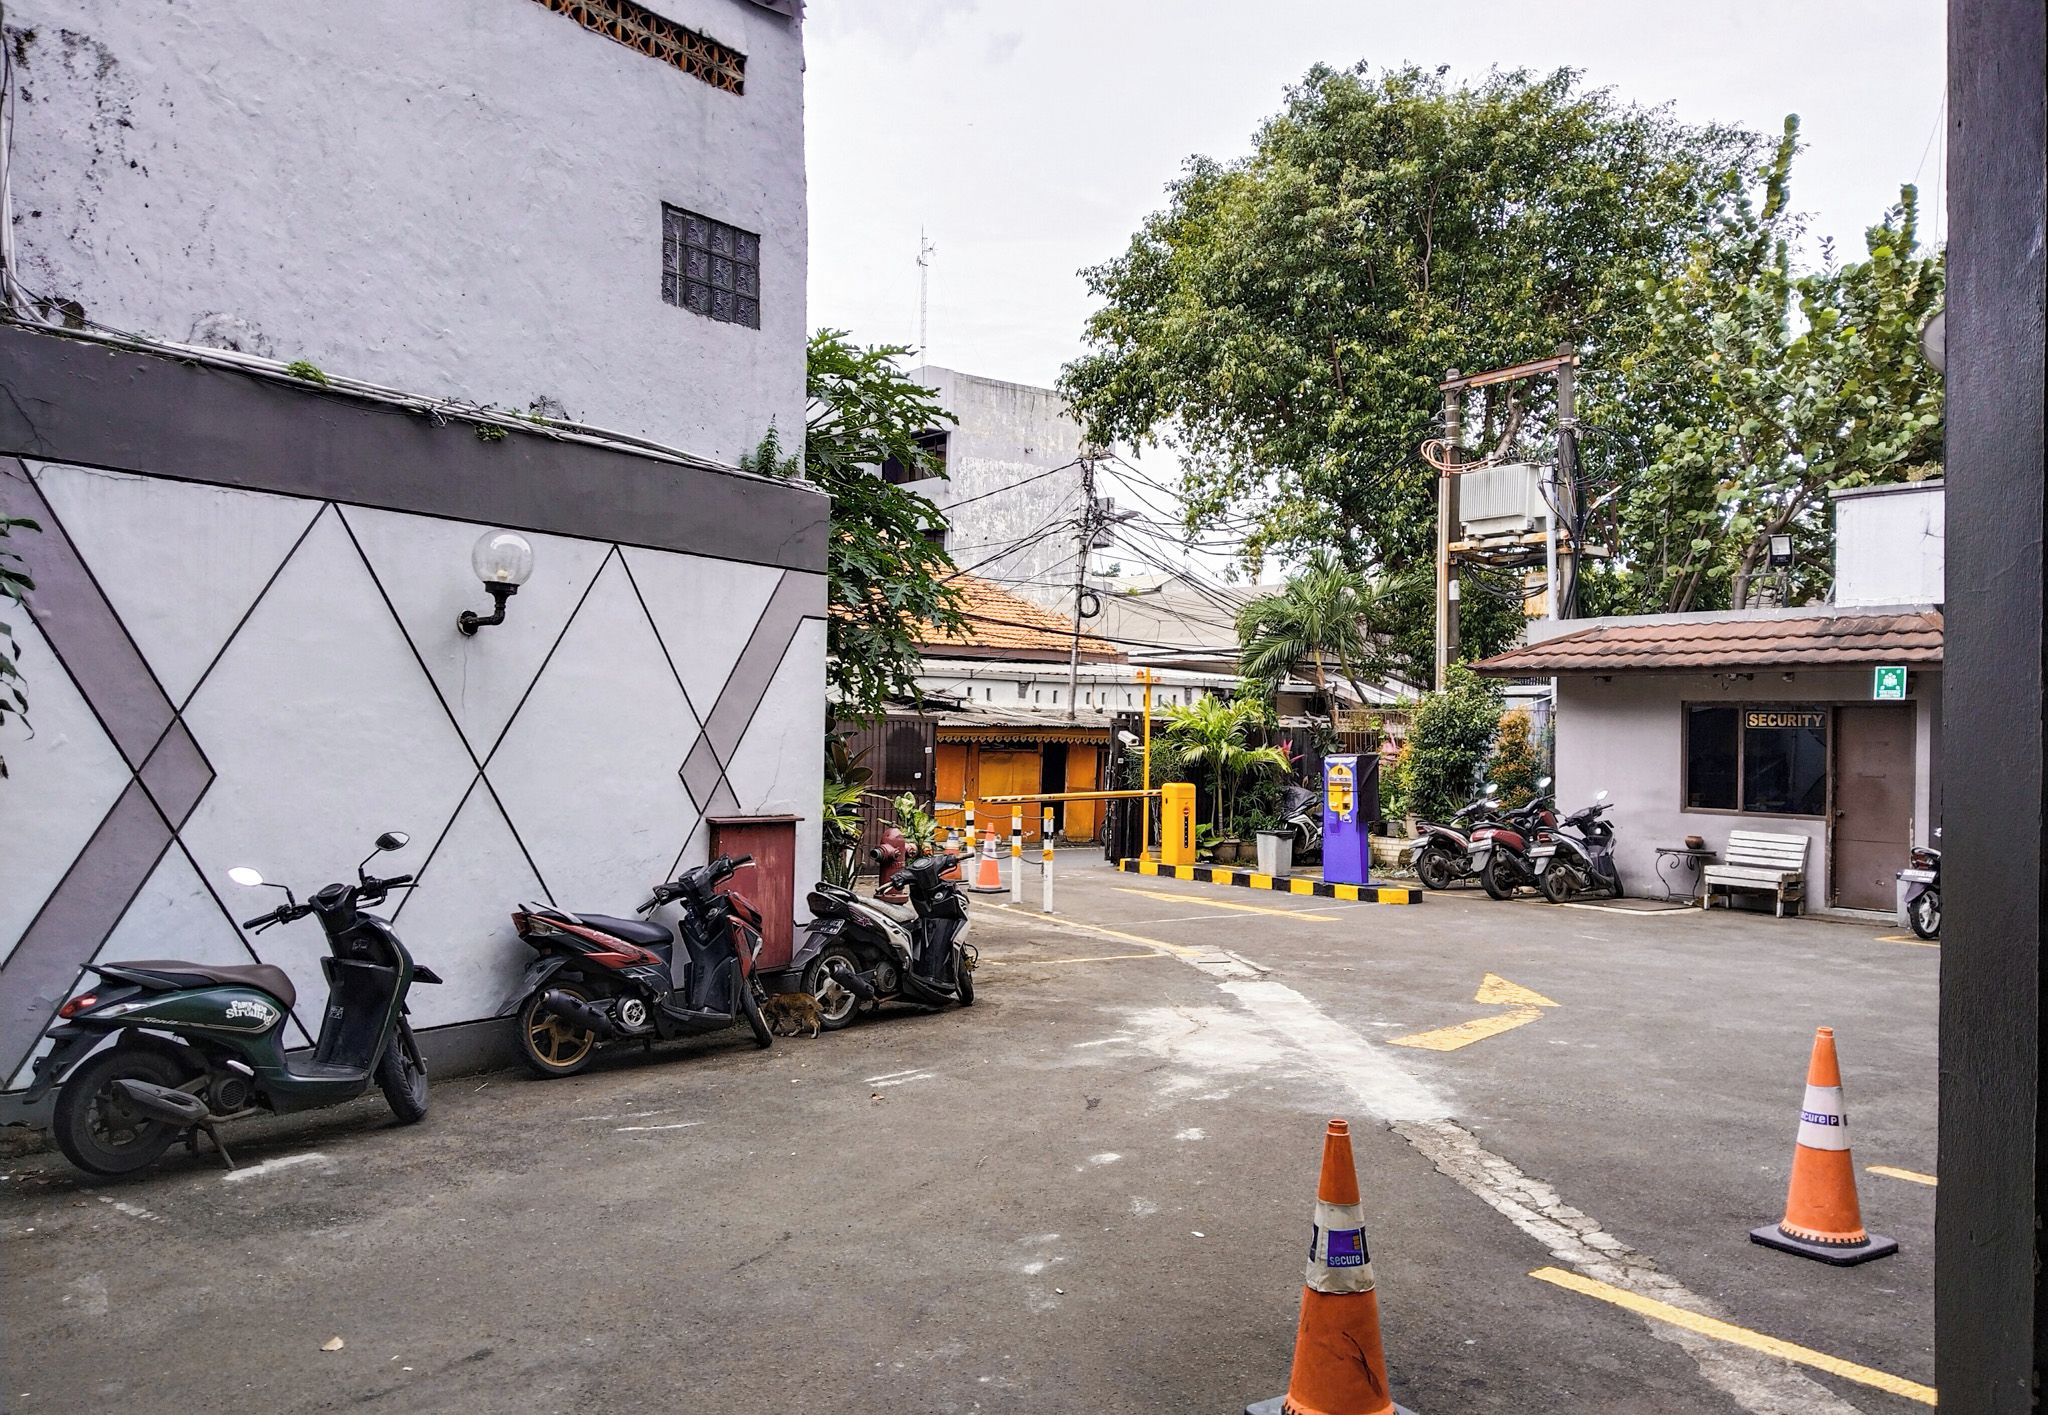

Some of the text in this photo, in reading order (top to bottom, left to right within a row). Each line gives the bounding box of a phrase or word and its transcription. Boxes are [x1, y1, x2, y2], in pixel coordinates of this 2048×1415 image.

[1749, 714, 1823, 727] SECURITY
[1830, 1116, 1838, 1125] P
[1330, 1255, 1361, 1266] secure
